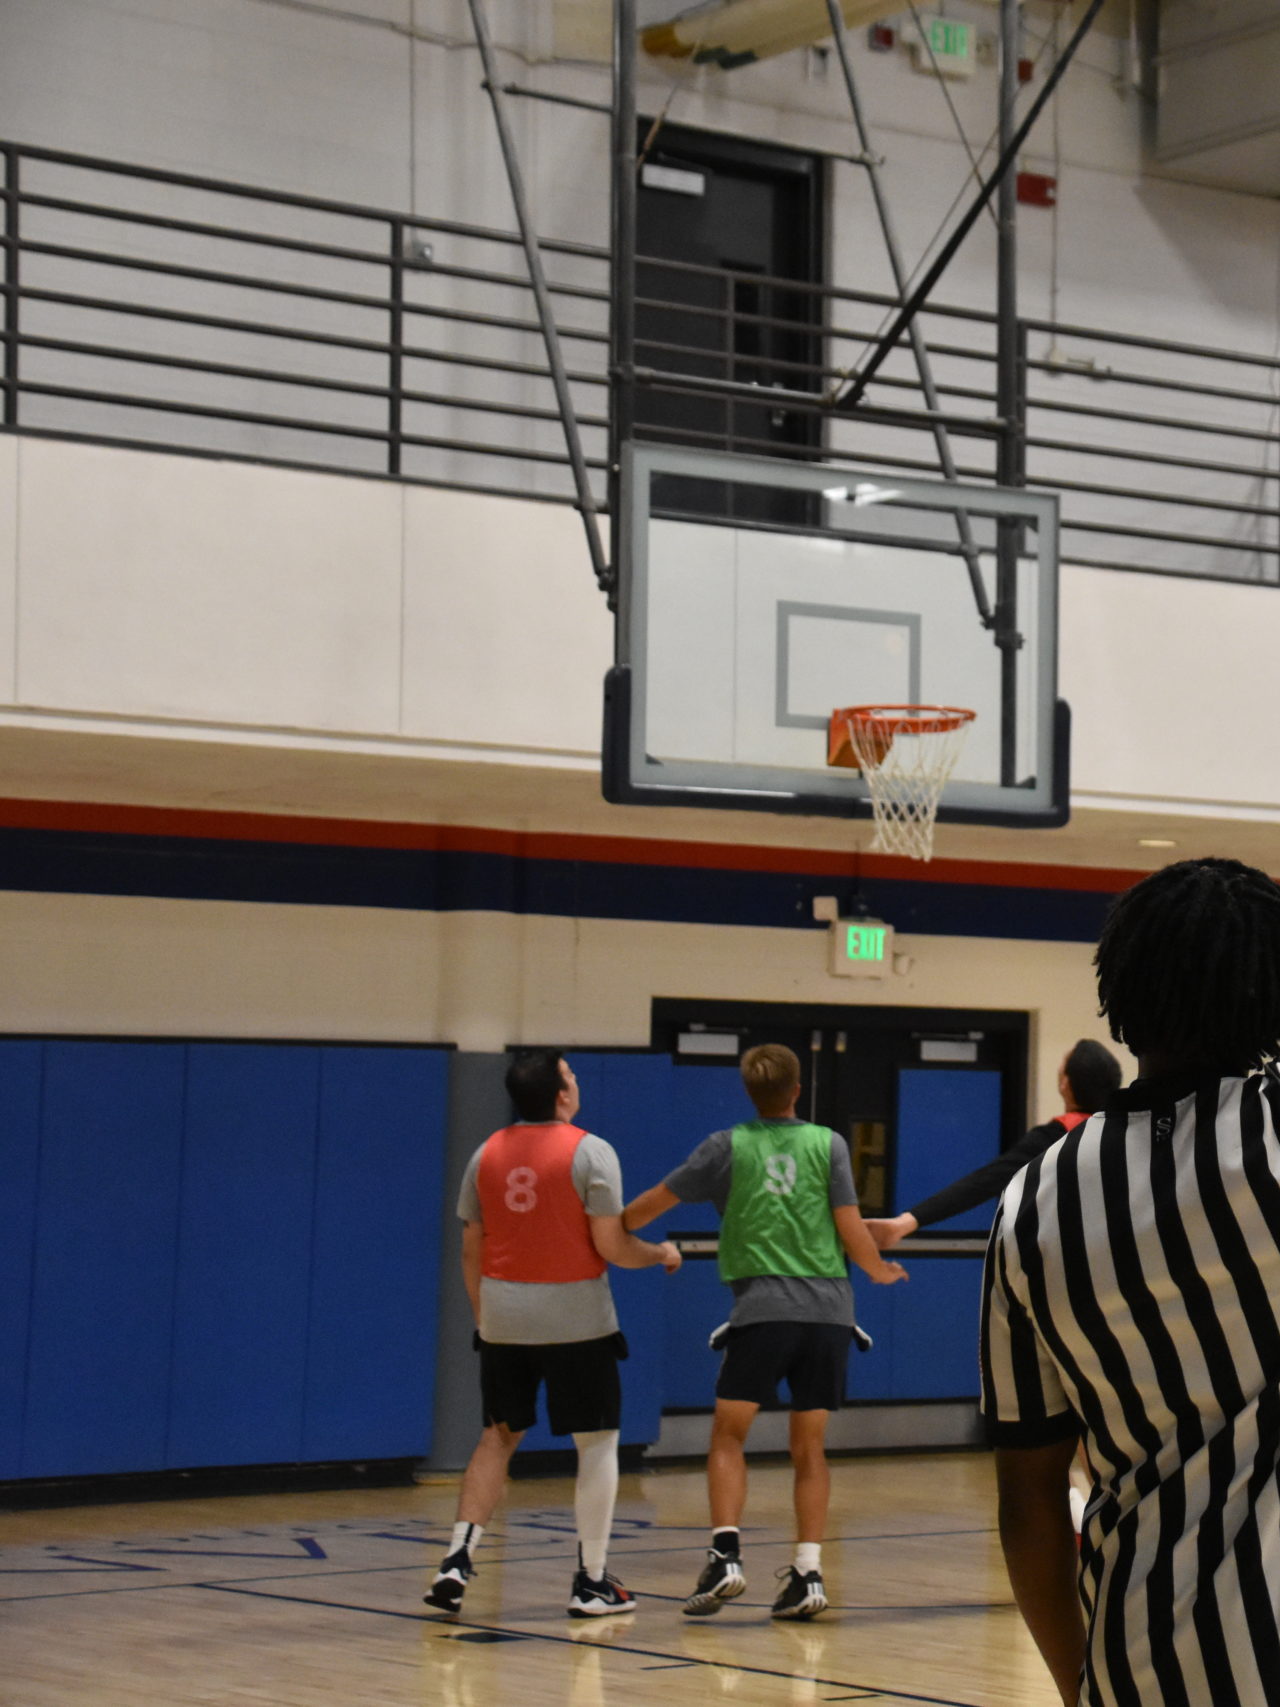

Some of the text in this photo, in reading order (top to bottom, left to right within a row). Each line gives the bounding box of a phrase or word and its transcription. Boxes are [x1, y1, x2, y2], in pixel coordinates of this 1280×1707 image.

[847, 925, 886, 961] EXIT
[504, 1166, 538, 1213] 8
[764, 1153, 797, 1195] 9
